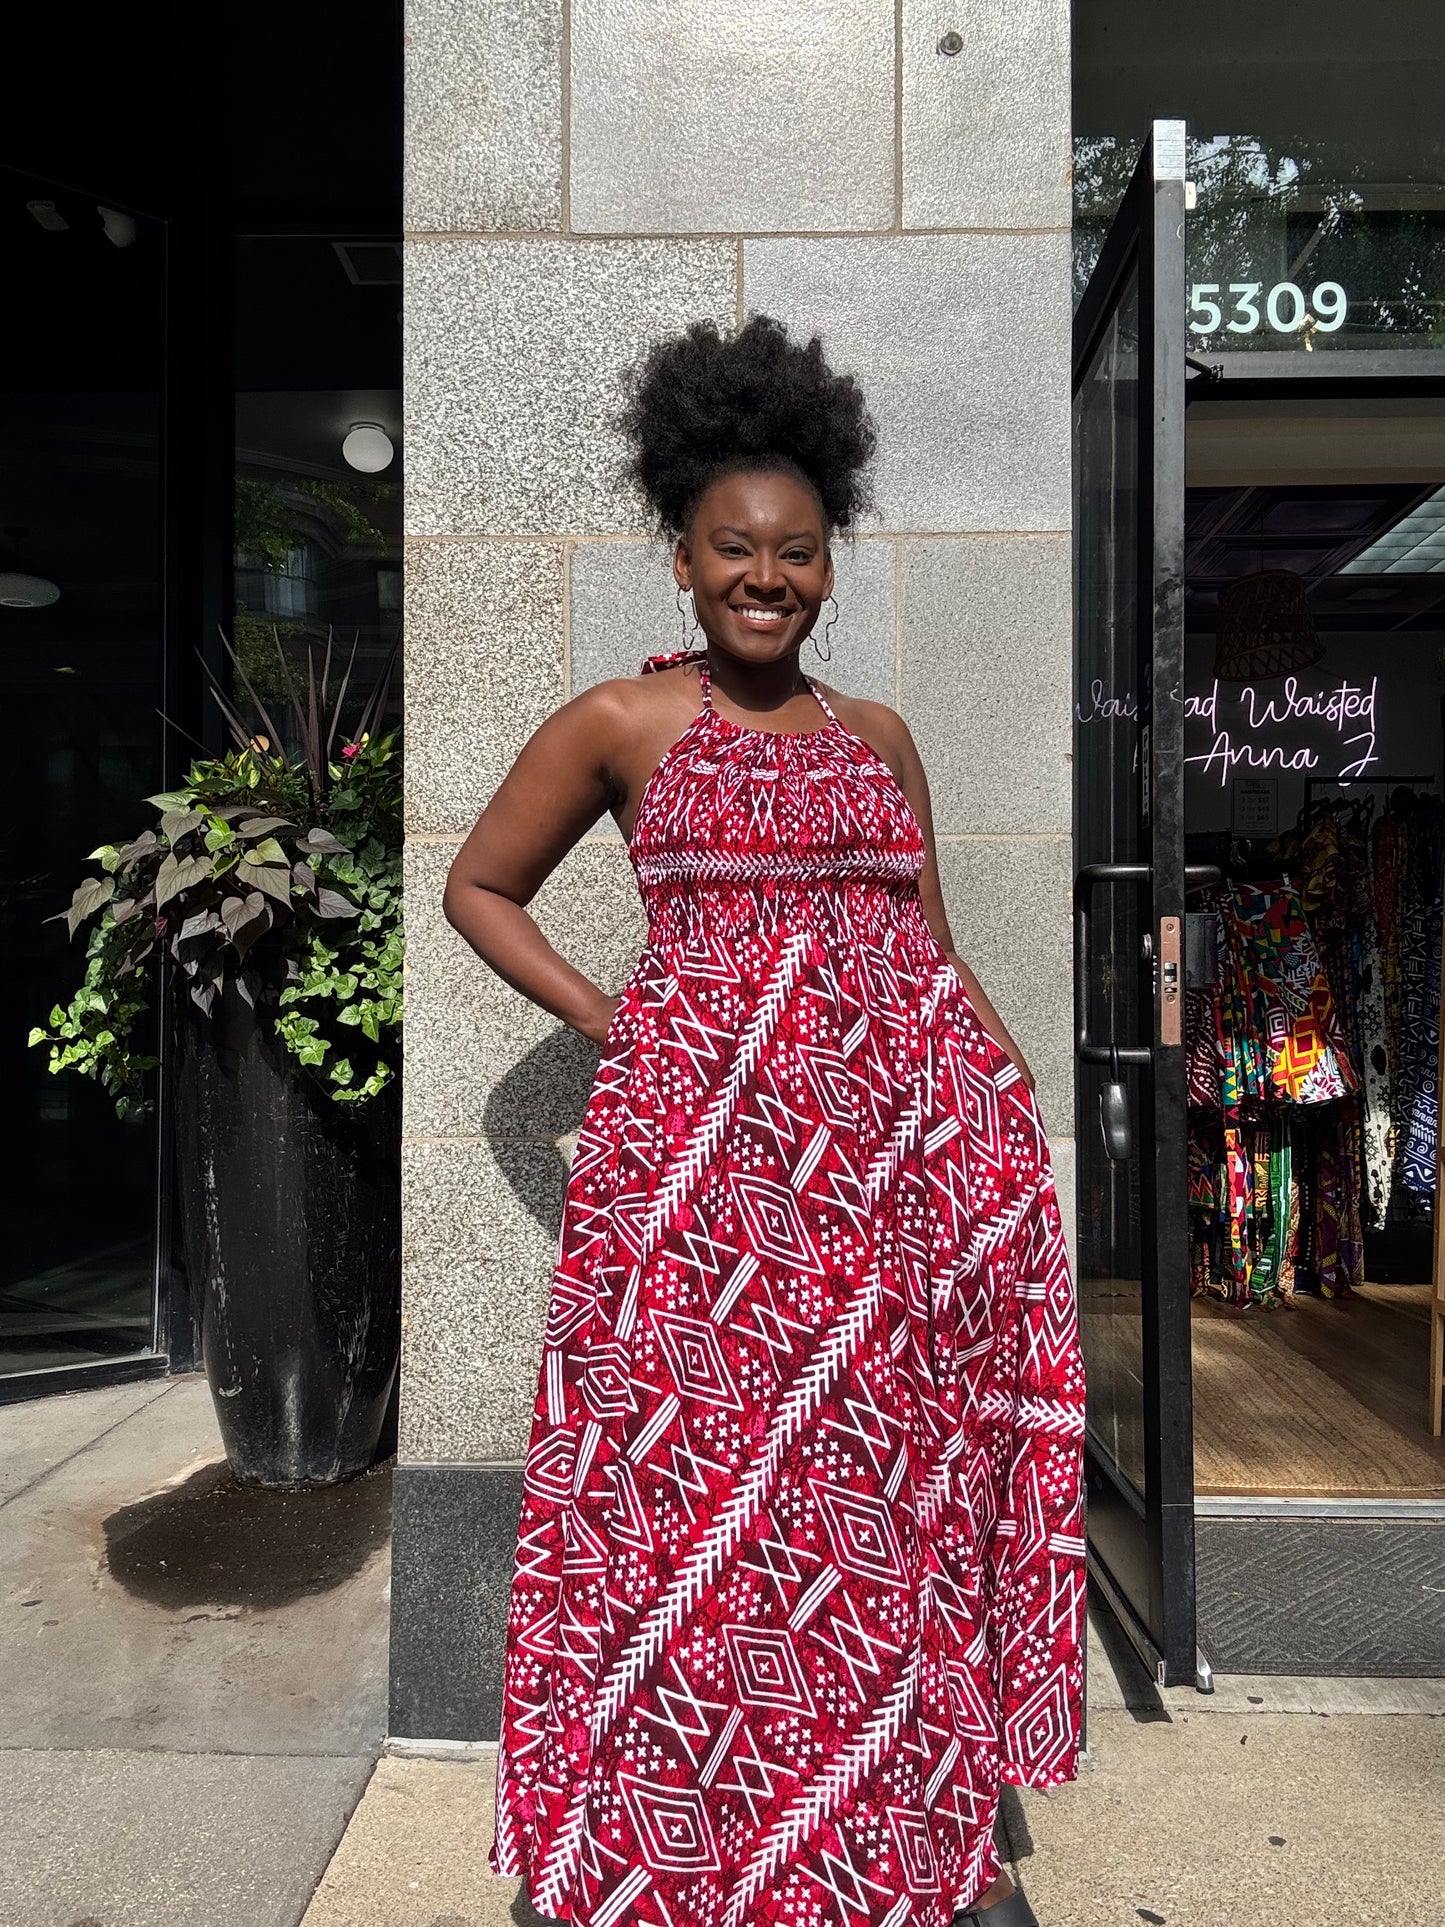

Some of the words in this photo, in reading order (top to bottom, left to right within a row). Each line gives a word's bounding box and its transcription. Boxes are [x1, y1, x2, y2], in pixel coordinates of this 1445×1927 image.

[1189, 282, 1347, 333] 5309
[1240, 676, 1377, 732] Waisted
[1184, 731, 1319, 787] Anna
